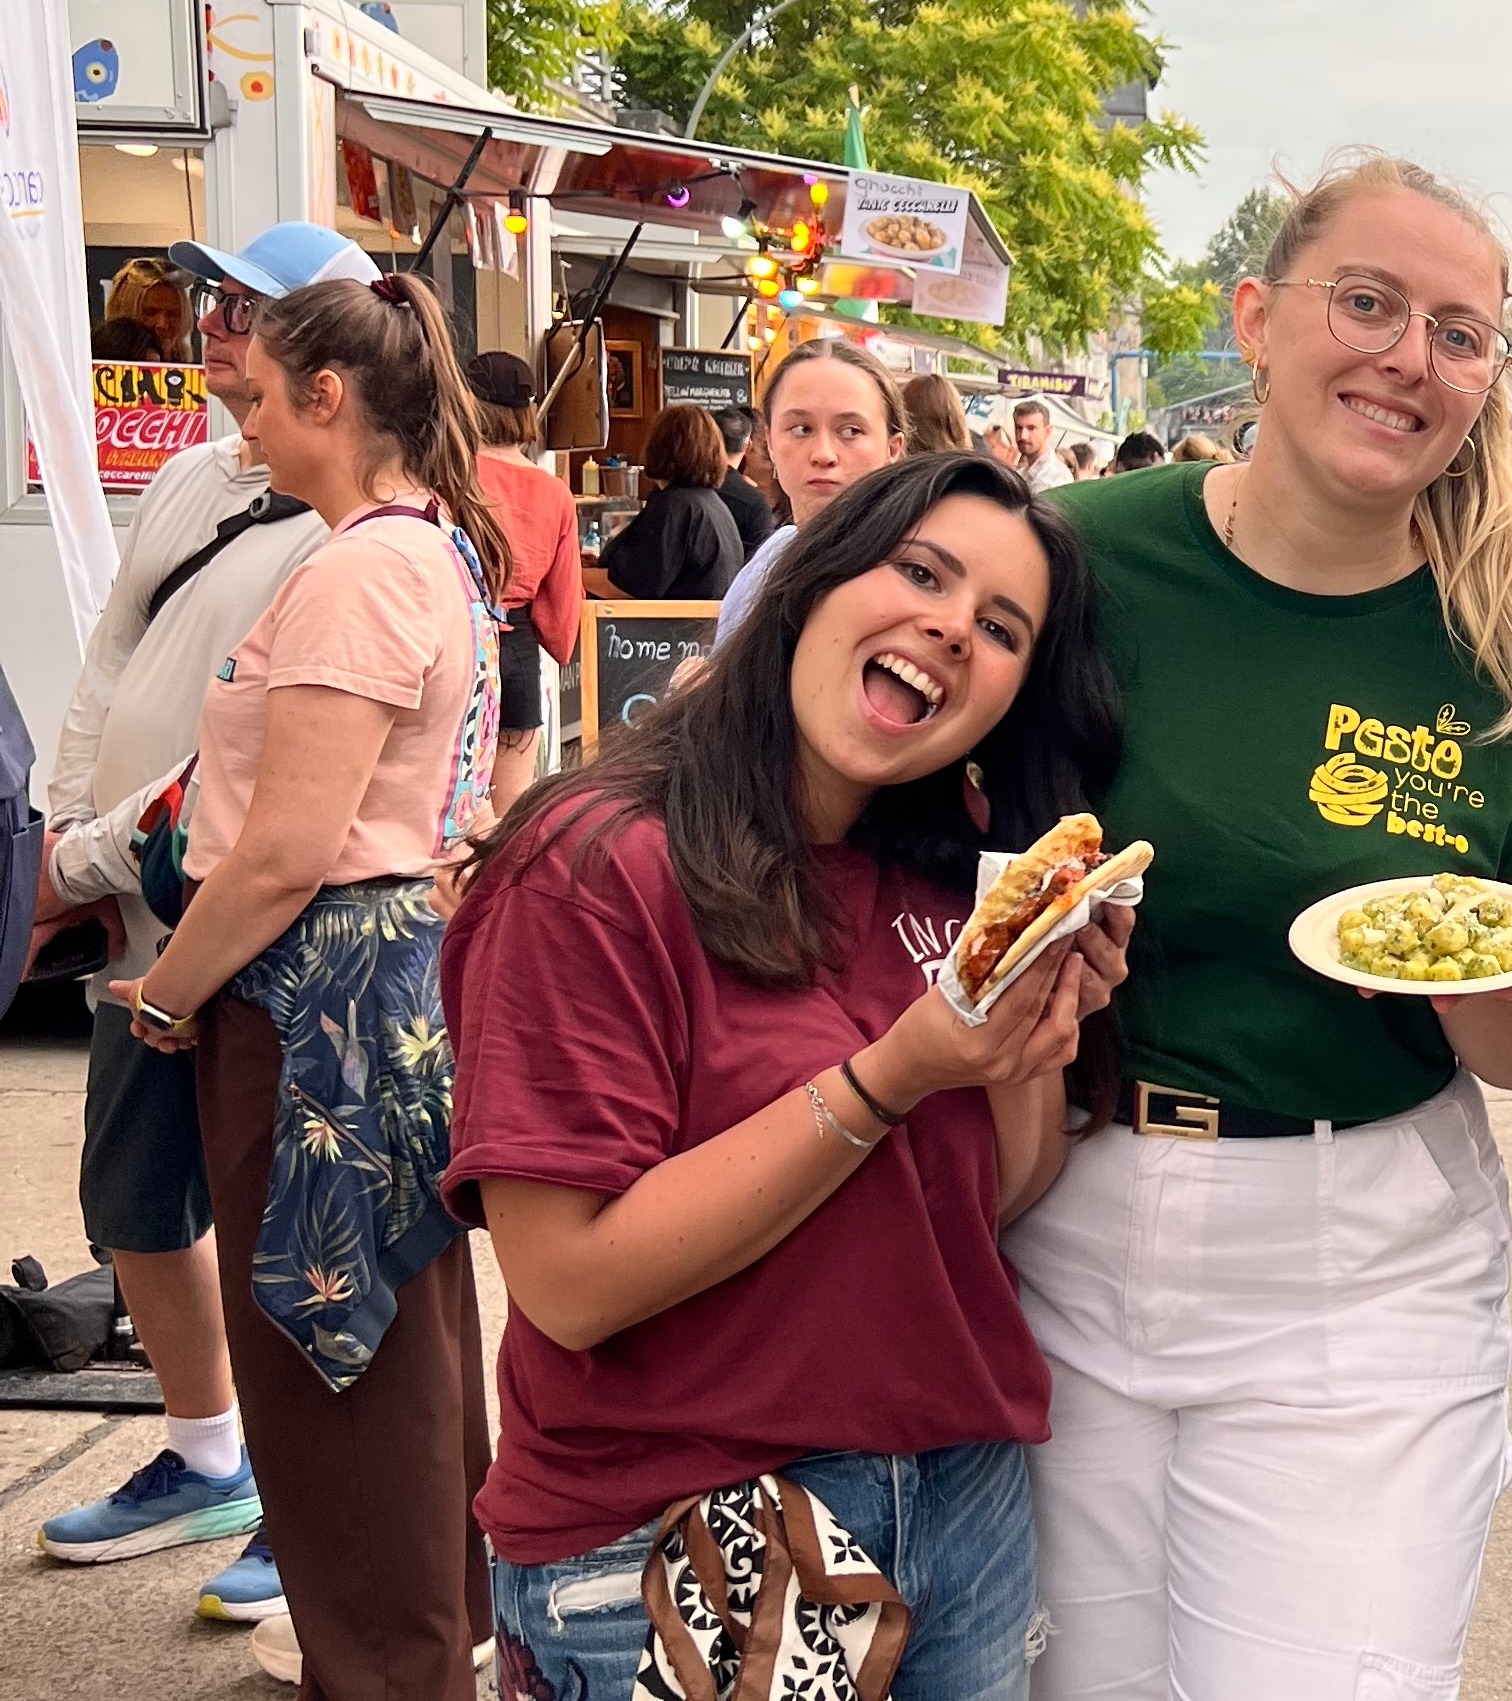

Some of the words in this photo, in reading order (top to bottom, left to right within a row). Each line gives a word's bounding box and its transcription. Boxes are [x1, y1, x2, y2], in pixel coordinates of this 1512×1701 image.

[95, 407, 207, 450] OCCHI
[605, 623, 671, 661] home
[1325, 704, 1463, 779] Pesto
[1391, 790, 1439, 820] the
[1394, 767, 1485, 809] you're
[1386, 811, 1469, 853] best-o
